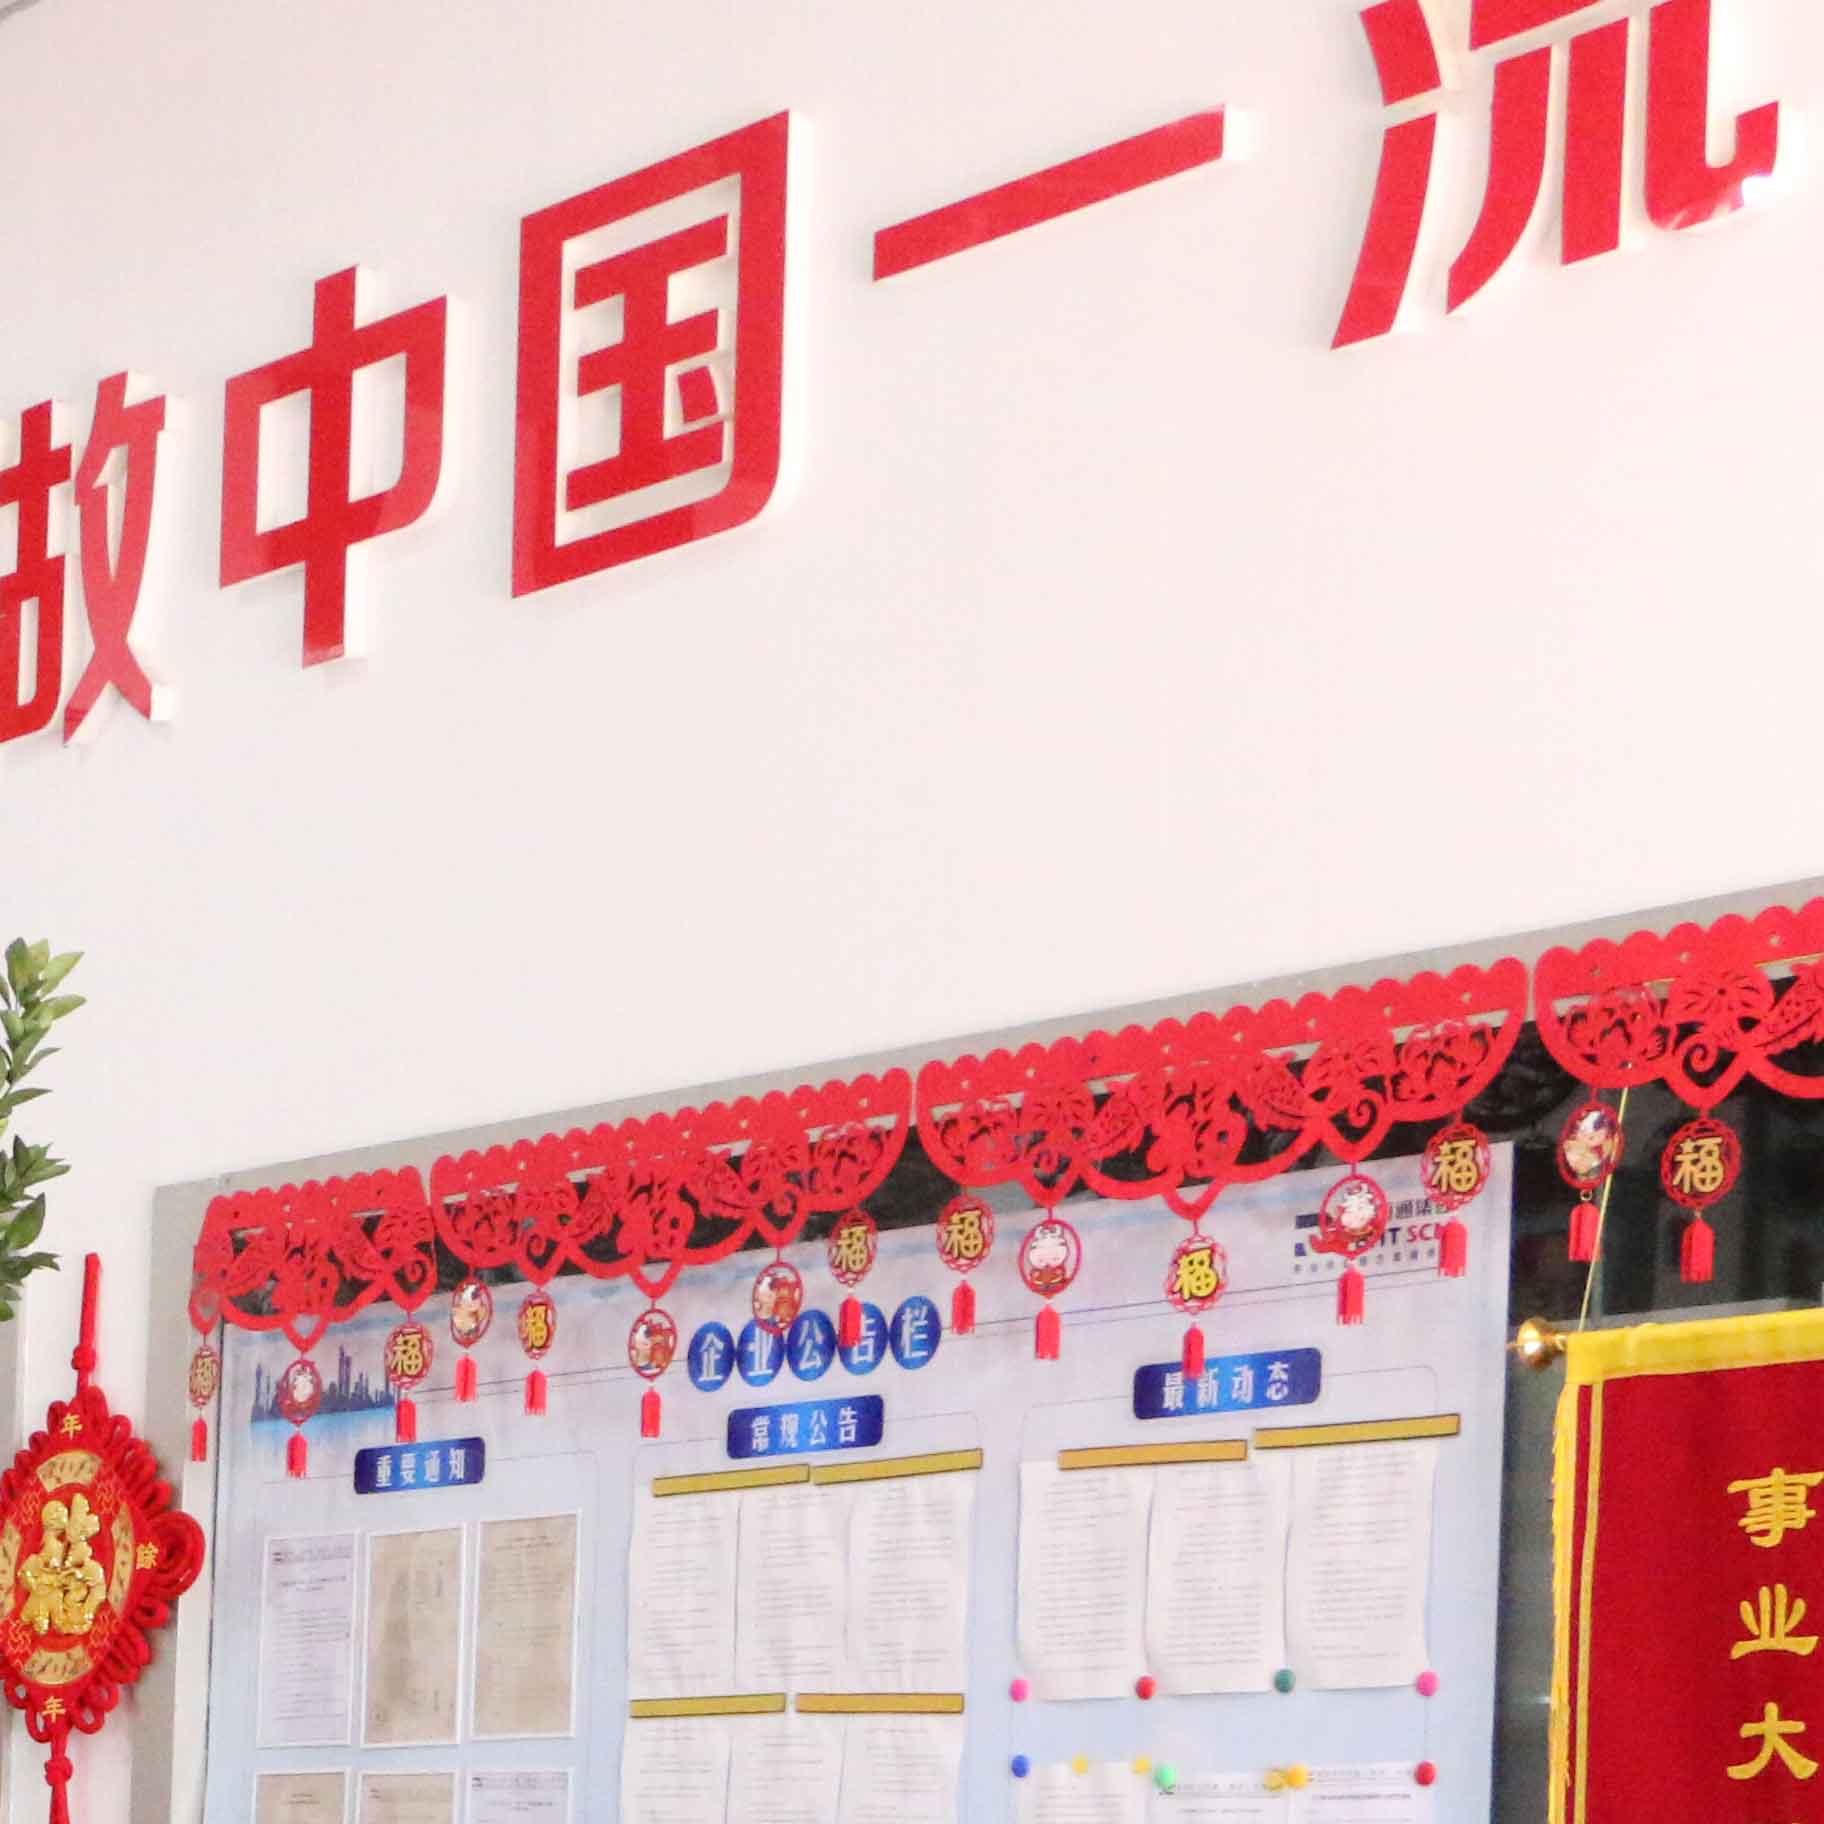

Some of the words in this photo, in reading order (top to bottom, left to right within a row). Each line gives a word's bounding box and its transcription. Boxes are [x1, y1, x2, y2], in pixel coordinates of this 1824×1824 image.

[1432, 1139, 1478, 1193] 福
[1672, 1136, 1724, 1194] 福
[834, 1225, 870, 1273] 福
[945, 1210, 984, 1259] 福
[1174, 1248, 1219, 1301] 福
[391, 1333, 424, 1377] 福
[698, 1306, 929, 1382] 企业公告栏
[1162, 1361, 1290, 1411] 最新动态
[750, 1406, 858, 1452] 常规公告
[375, 1447, 465, 1488] 重要通知
